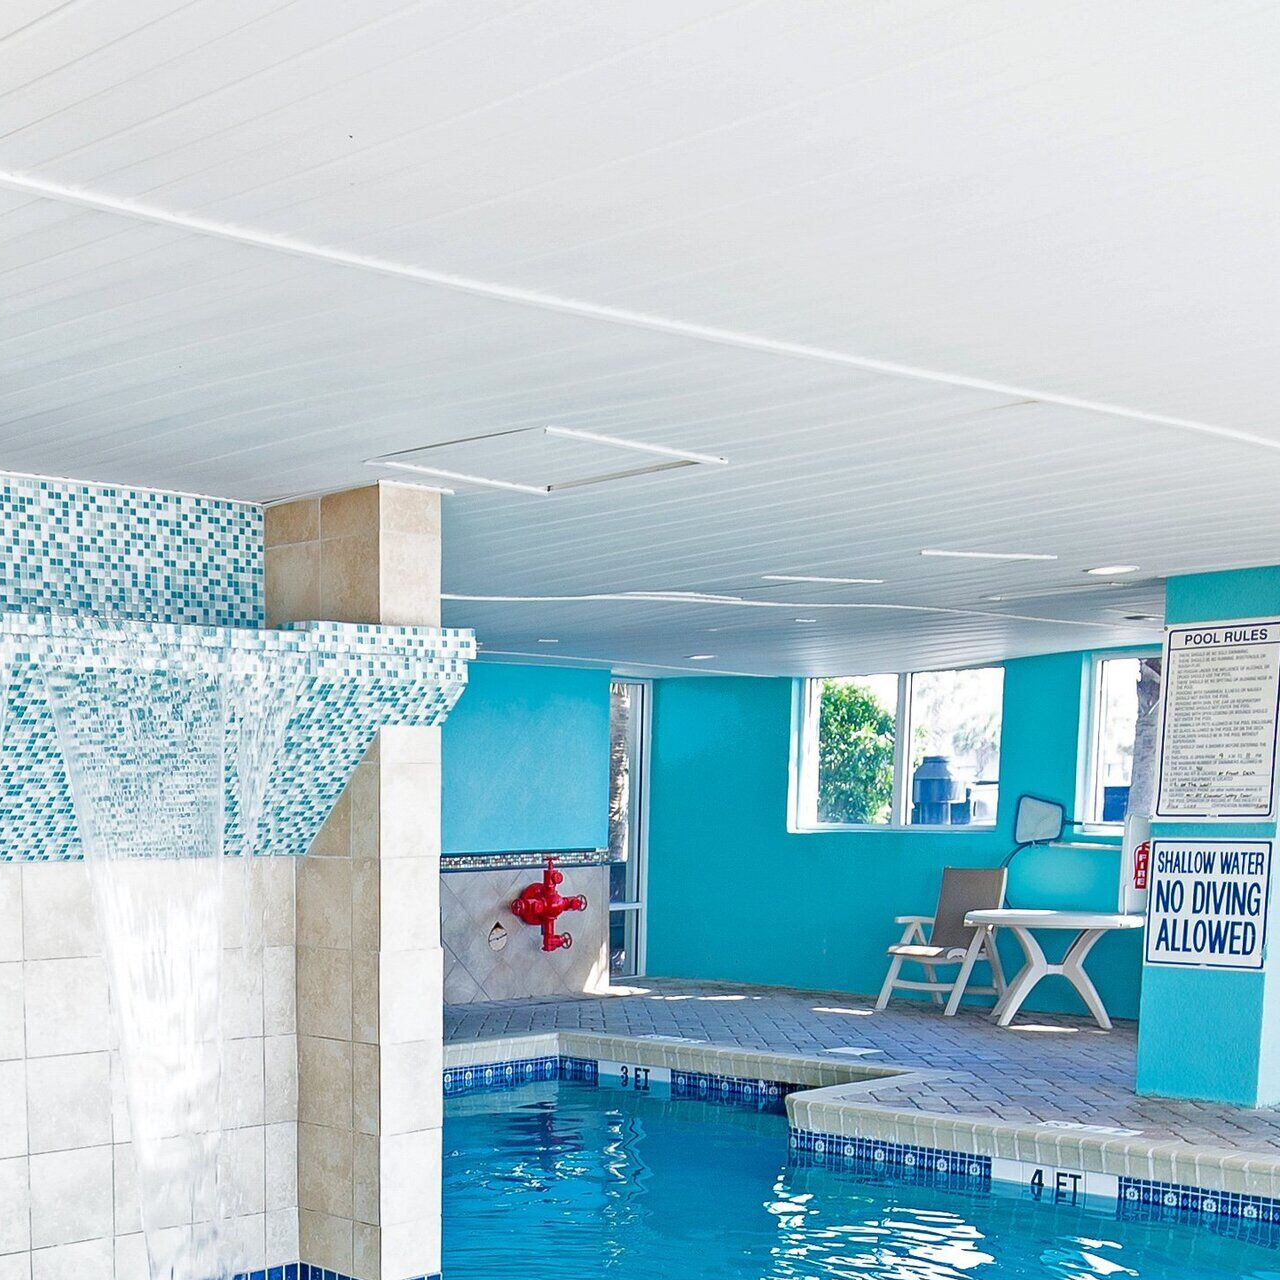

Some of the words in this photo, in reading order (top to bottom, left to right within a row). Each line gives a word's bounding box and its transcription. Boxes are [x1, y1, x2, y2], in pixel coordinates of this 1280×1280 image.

[1184, 632, 1220, 645] POOL
[1224, 628, 1268, 643] RULES
[1137, 853, 1148, 886] FIRE
[1157, 851, 1216, 874] SHALLOW
[1220, 852, 1265, 876] WATER
[1155, 880, 1184, 913] NO
[1192, 881, 1262, 917] DIVING
[1155, 918, 1257, 956] ALLOWED
[1031, 1168, 1044, 1189] 4
